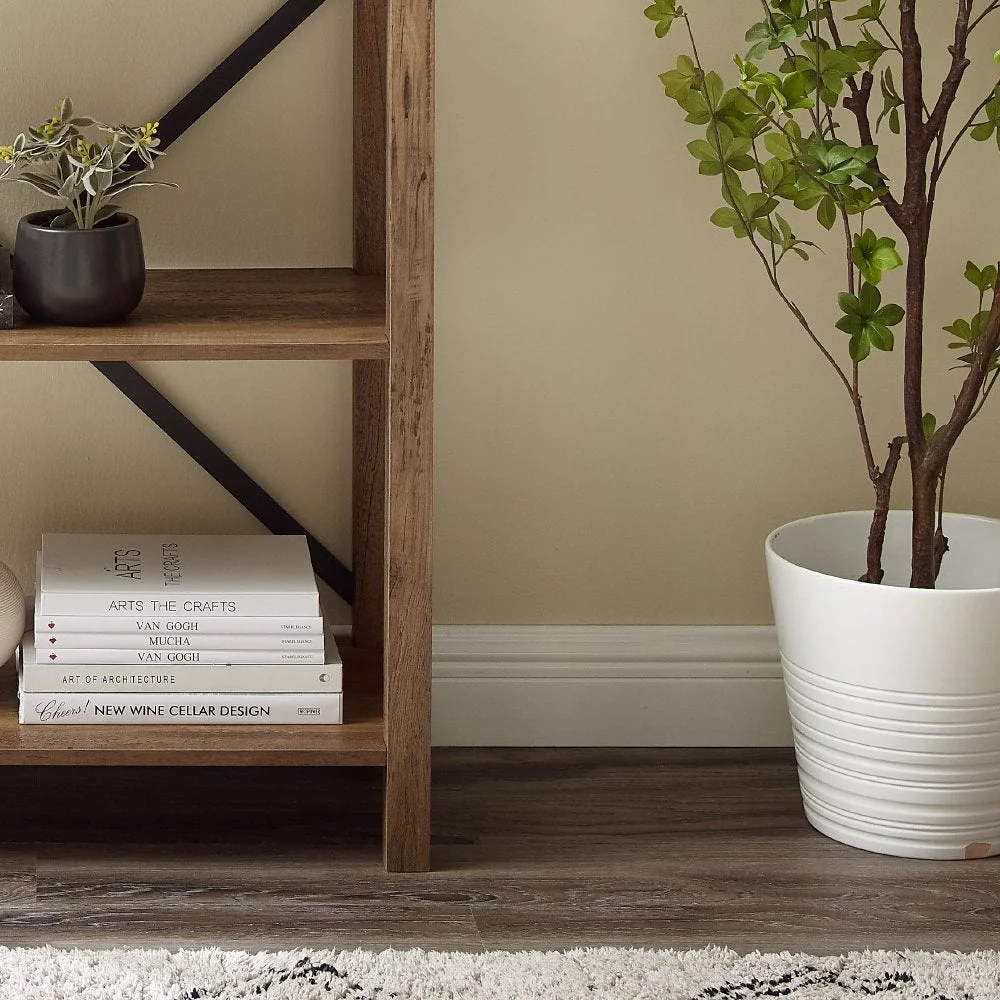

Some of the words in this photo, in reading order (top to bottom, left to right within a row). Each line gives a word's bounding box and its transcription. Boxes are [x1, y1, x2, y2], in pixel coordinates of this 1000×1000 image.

[115, 549, 142, 580] ARTS
[108, 600, 144, 612] ARTS
[150, 600, 177, 612] THE
[183, 600, 237, 613] CRAFTS
[136, 621, 161, 631] VAN
[166, 621, 199, 631] GOGH
[149, 636, 191, 647] MUCHA
[137, 652, 162, 662] VAN
[167, 652, 200, 663] GOGH
[62, 675, 81, 684] ART
[85, 675, 98, 684] OF
[102, 675, 176, 684] ARCHITECTURE
[35, 699, 90, 722] Cheers!
[94, 705, 126, 716] NEW
[130, 705, 165, 716] WINE
[169, 705, 217, 717] CELLAR
[220, 705, 271, 717] DESIGN
